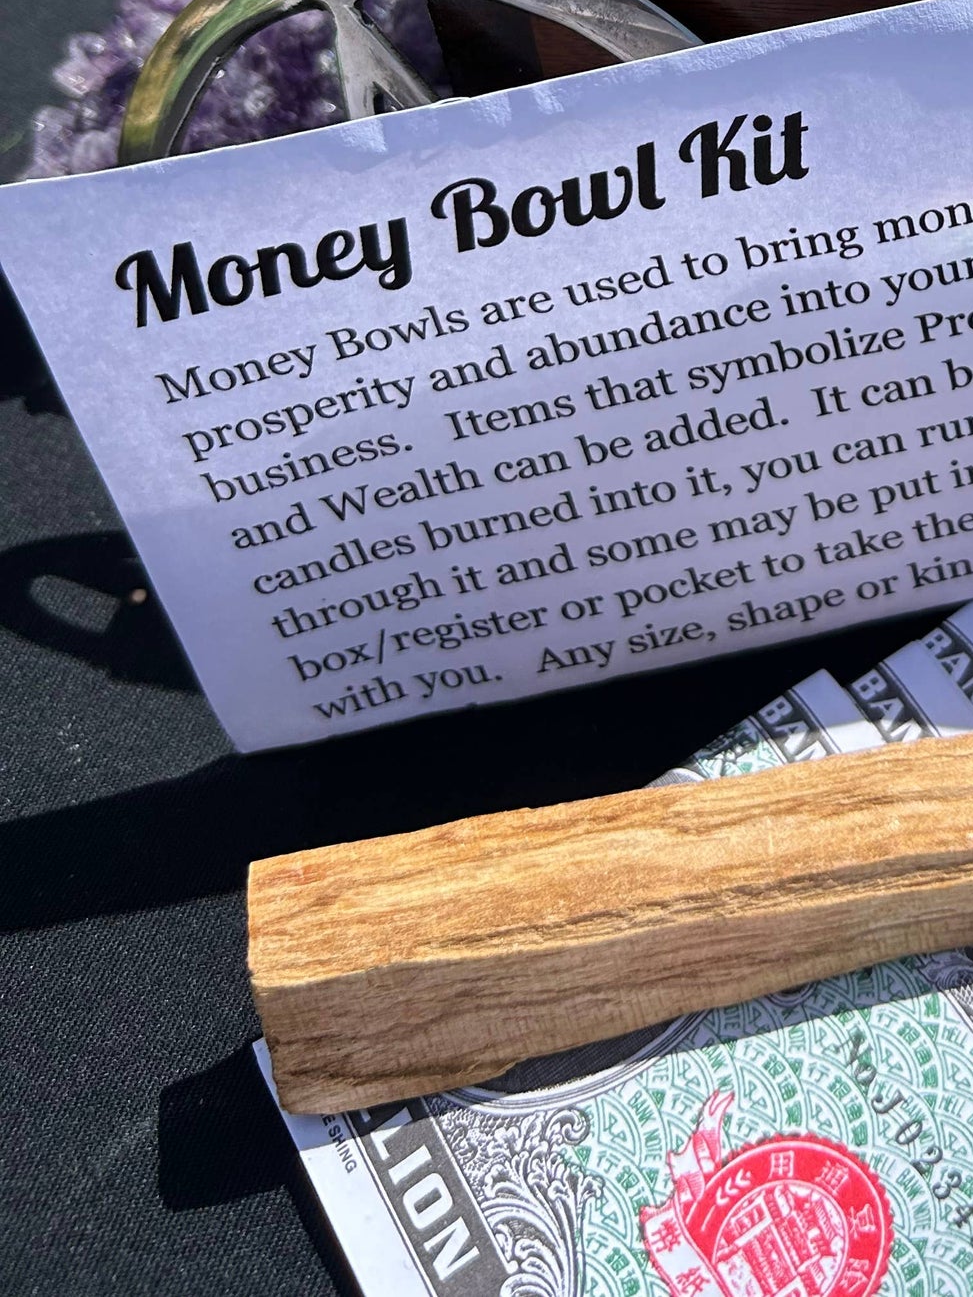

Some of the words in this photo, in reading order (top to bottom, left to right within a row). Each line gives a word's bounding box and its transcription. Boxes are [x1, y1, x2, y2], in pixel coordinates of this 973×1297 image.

[115, 217, 412, 328] Money
[431, 142, 666, 253] Bowl
[679, 111, 809, 199] Kit
[155, 345, 316, 404] Money
[325, 306, 469, 360] Bowls
[481, 292, 554, 325] are
[563, 255, 674, 306] used
[681, 253, 728, 280] to
[735, 227, 863, 270] bring
[182, 376, 415, 462] prosperity
[430, 345, 517, 392] and
[527, 300, 771, 370] abundance
[781, 281, 870, 316] into
[200, 434, 412, 502] business.
[444, 395, 576, 440] Items
[584, 369, 677, 410] that
[688, 327, 905, 394] symbolize
[231, 502, 317, 549] and
[318, 461, 484, 521] Wealth
[494, 451, 571, 483] can
[574, 435, 633, 466] be
[644, 397, 789, 452] added.
[810, 386, 850, 417] It
[861, 375, 936, 406] can
[254, 535, 415, 594] candles
[418, 491, 583, 551] burned
[589, 482, 676, 515] into
[686, 467, 732, 496] it,
[740, 451, 822, 493] you
[833, 433, 907, 464] can
[272, 572, 445, 638] through
[452, 566, 487, 594] it
[497, 543, 577, 585] and
[587, 529, 698, 567] some
[708, 506, 797, 542] may
[804, 492, 859, 521] be
[868, 471, 941, 515] put
[287, 607, 547, 682] box/register
[561, 596, 603, 620] or
[614, 561, 754, 618] pocket
[762, 554, 804, 577] to
[814, 530, 903, 564] take
[313, 677, 408, 718] with
[413, 665, 502, 699] you.
[537, 641, 615, 673] Any
[628, 621, 718, 654] size,
[728, 589, 845, 626] shape
[857, 576, 898, 599] or
[328, 1124, 357, 1174] SHING
